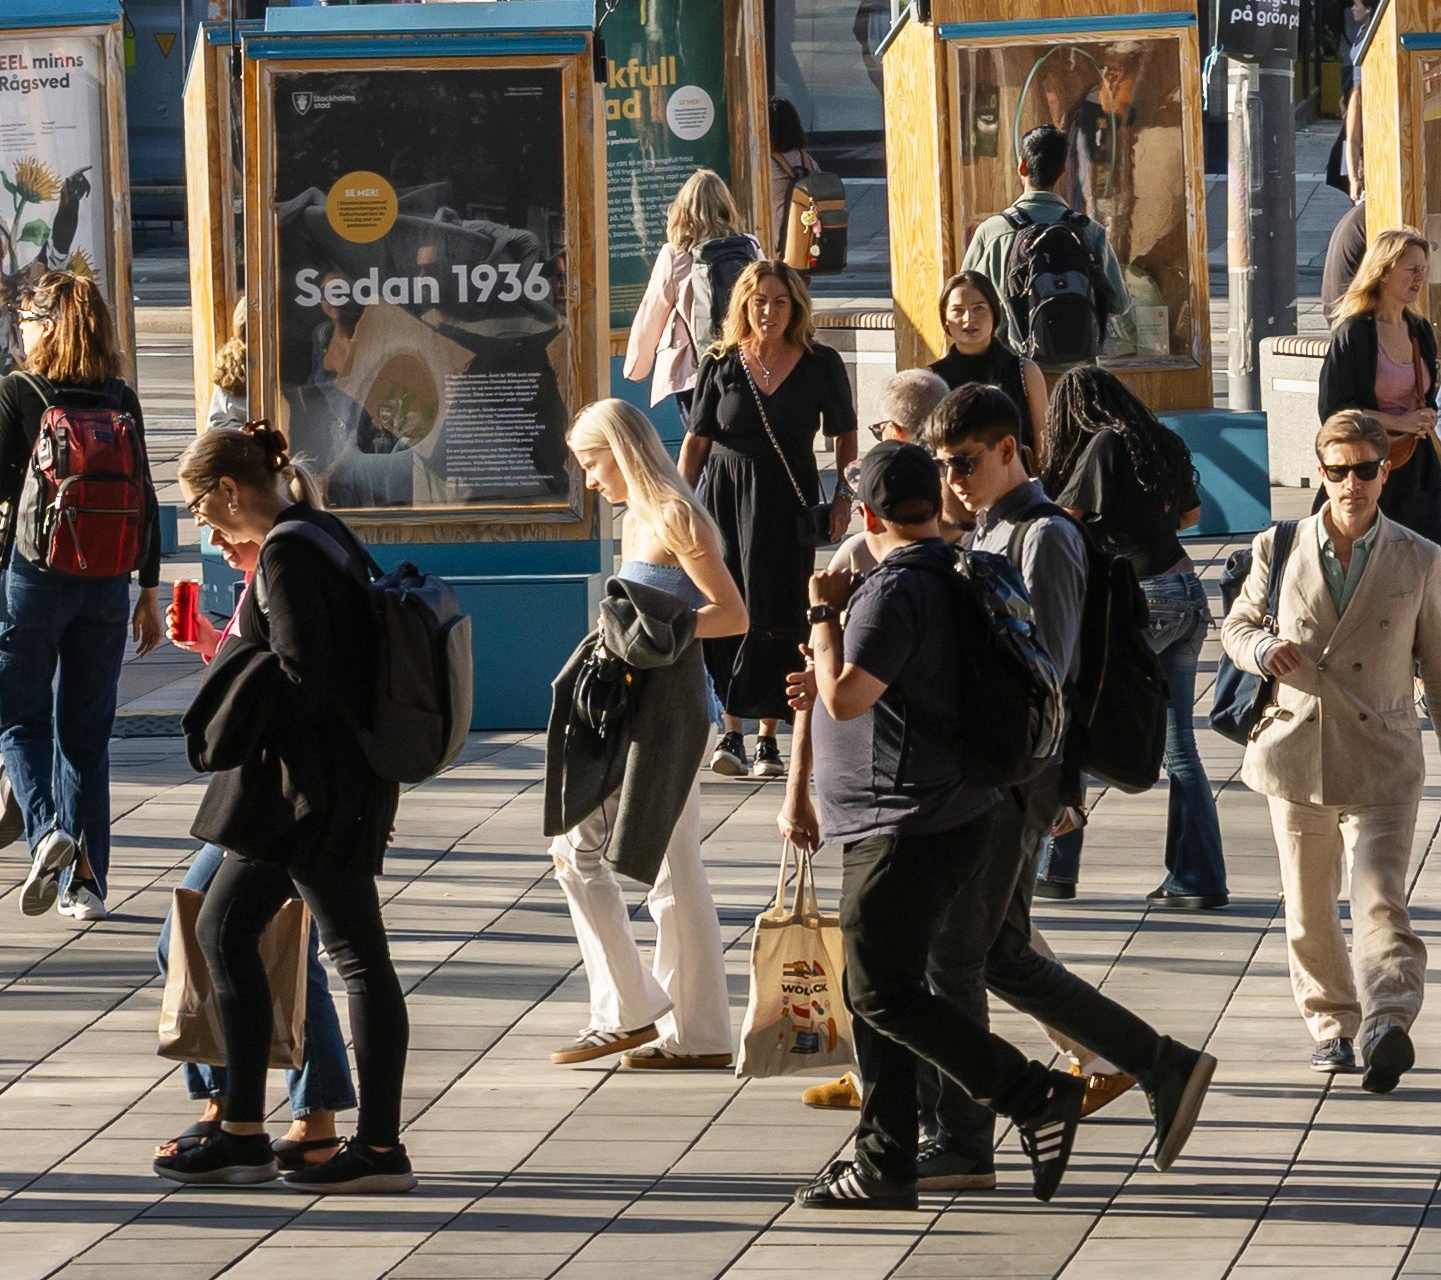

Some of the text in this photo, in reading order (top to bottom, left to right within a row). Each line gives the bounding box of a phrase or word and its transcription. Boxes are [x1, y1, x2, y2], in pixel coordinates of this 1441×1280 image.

[1230, 5, 1288, 26] på grön
[32, 52, 84, 69] minns
[608, 55, 677, 89] kfull
[313, 94, 356, 103] Stockholms
[313, 101, 332, 110] stad
[606, 90, 642, 121] ad
[294, 262, 551, 308] Sedan 1936
